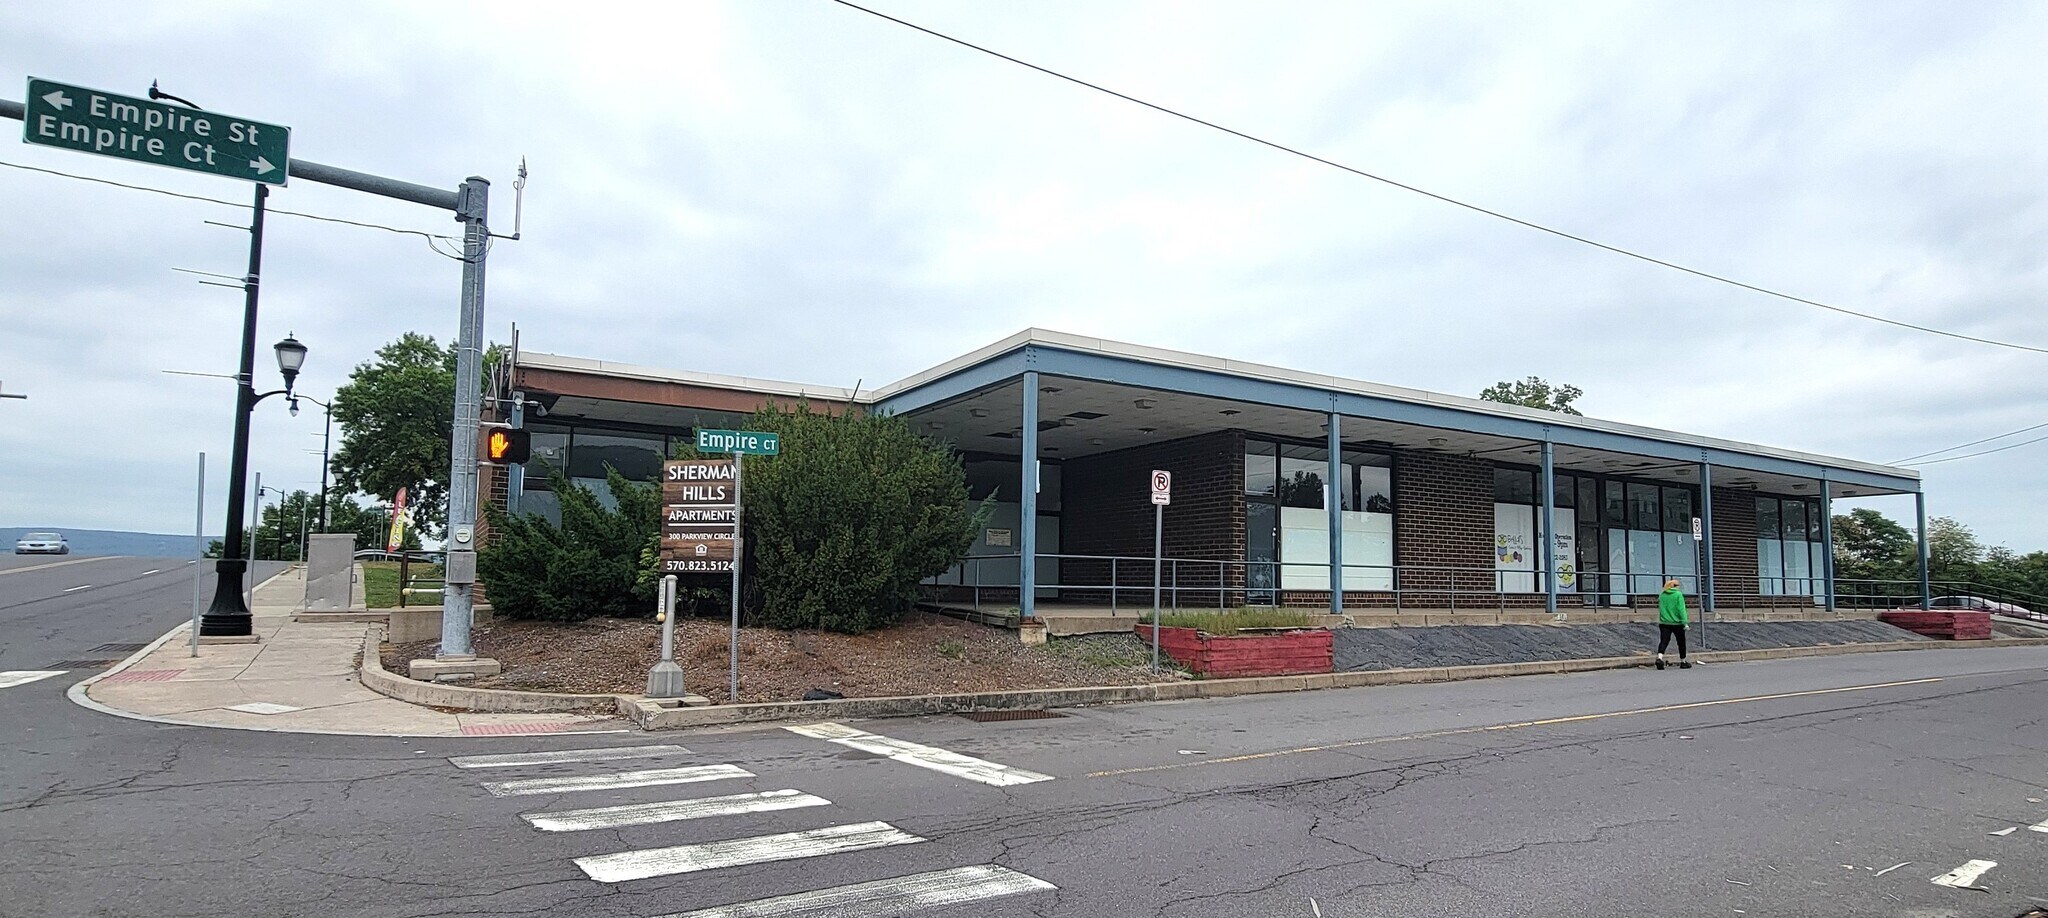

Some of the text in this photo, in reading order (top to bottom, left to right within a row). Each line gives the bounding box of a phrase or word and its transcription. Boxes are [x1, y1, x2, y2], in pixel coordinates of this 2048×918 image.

[90, 94, 259, 146] Empire St
[39, 114, 216, 166] Empire Ct
[700, 431, 776, 452] Empire CT
[668, 464, 736, 480] SHERMAN
[683, 486, 726, 501] HILLS
[668, 510, 736, 521] APARTMENTS
[666, 560, 735, 571] 570.823.5124
